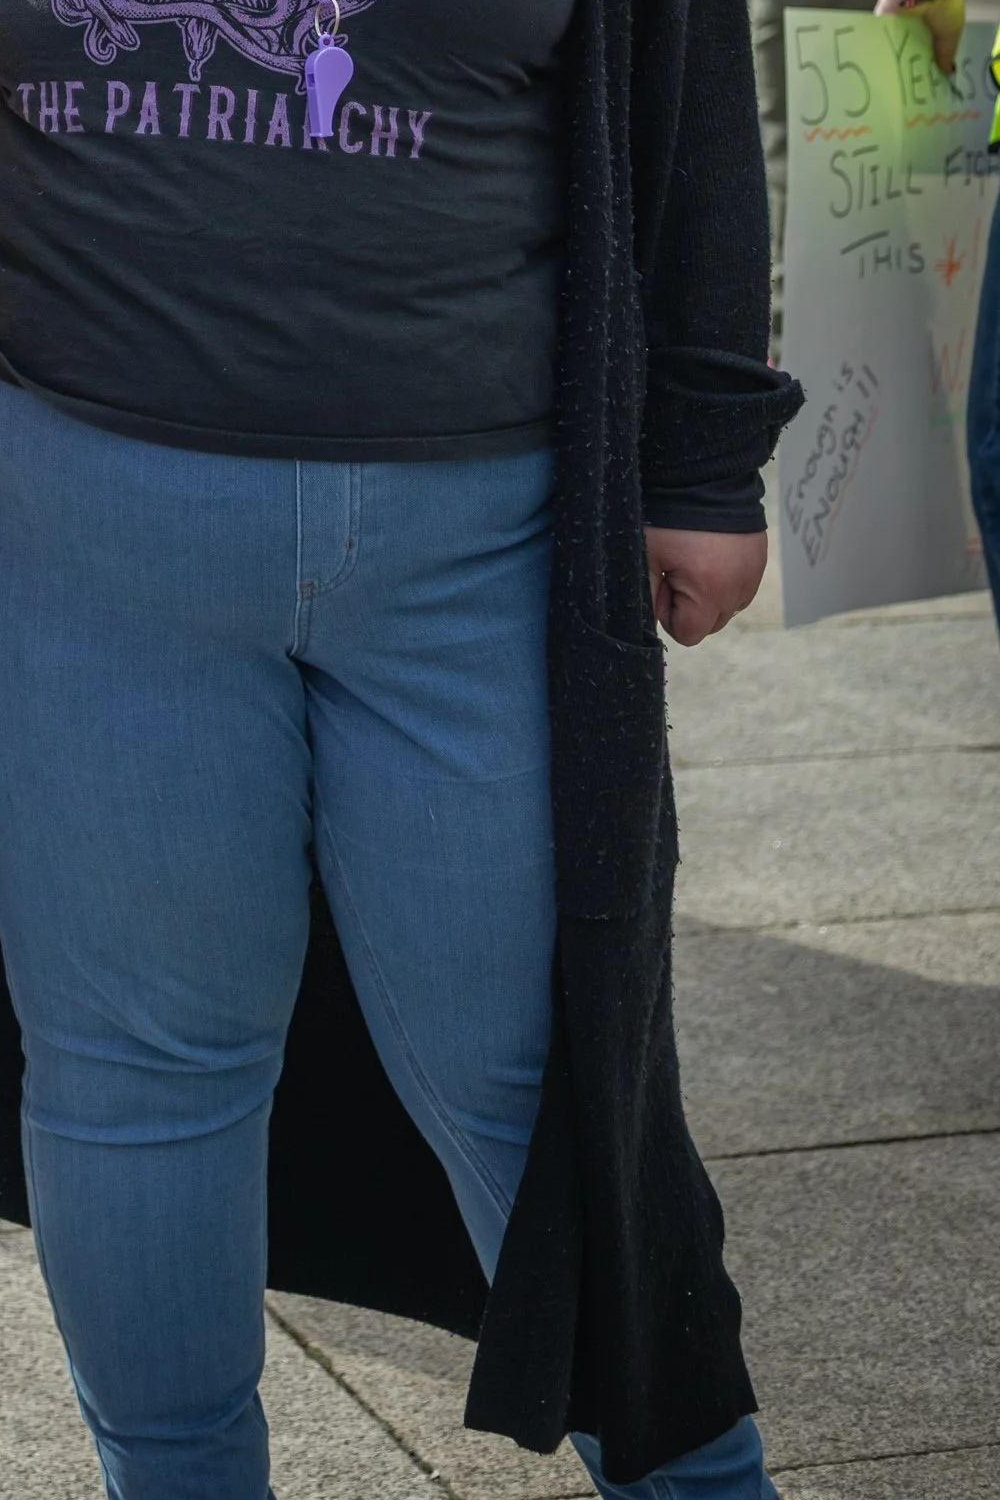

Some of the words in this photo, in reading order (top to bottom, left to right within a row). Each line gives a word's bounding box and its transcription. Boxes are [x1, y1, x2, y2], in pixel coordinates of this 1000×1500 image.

[16, 80, 86, 133] THE
[796, 25, 871, 126] 55
[829, 145, 923, 218] STILL
[840, 229, 925, 279] THIS
